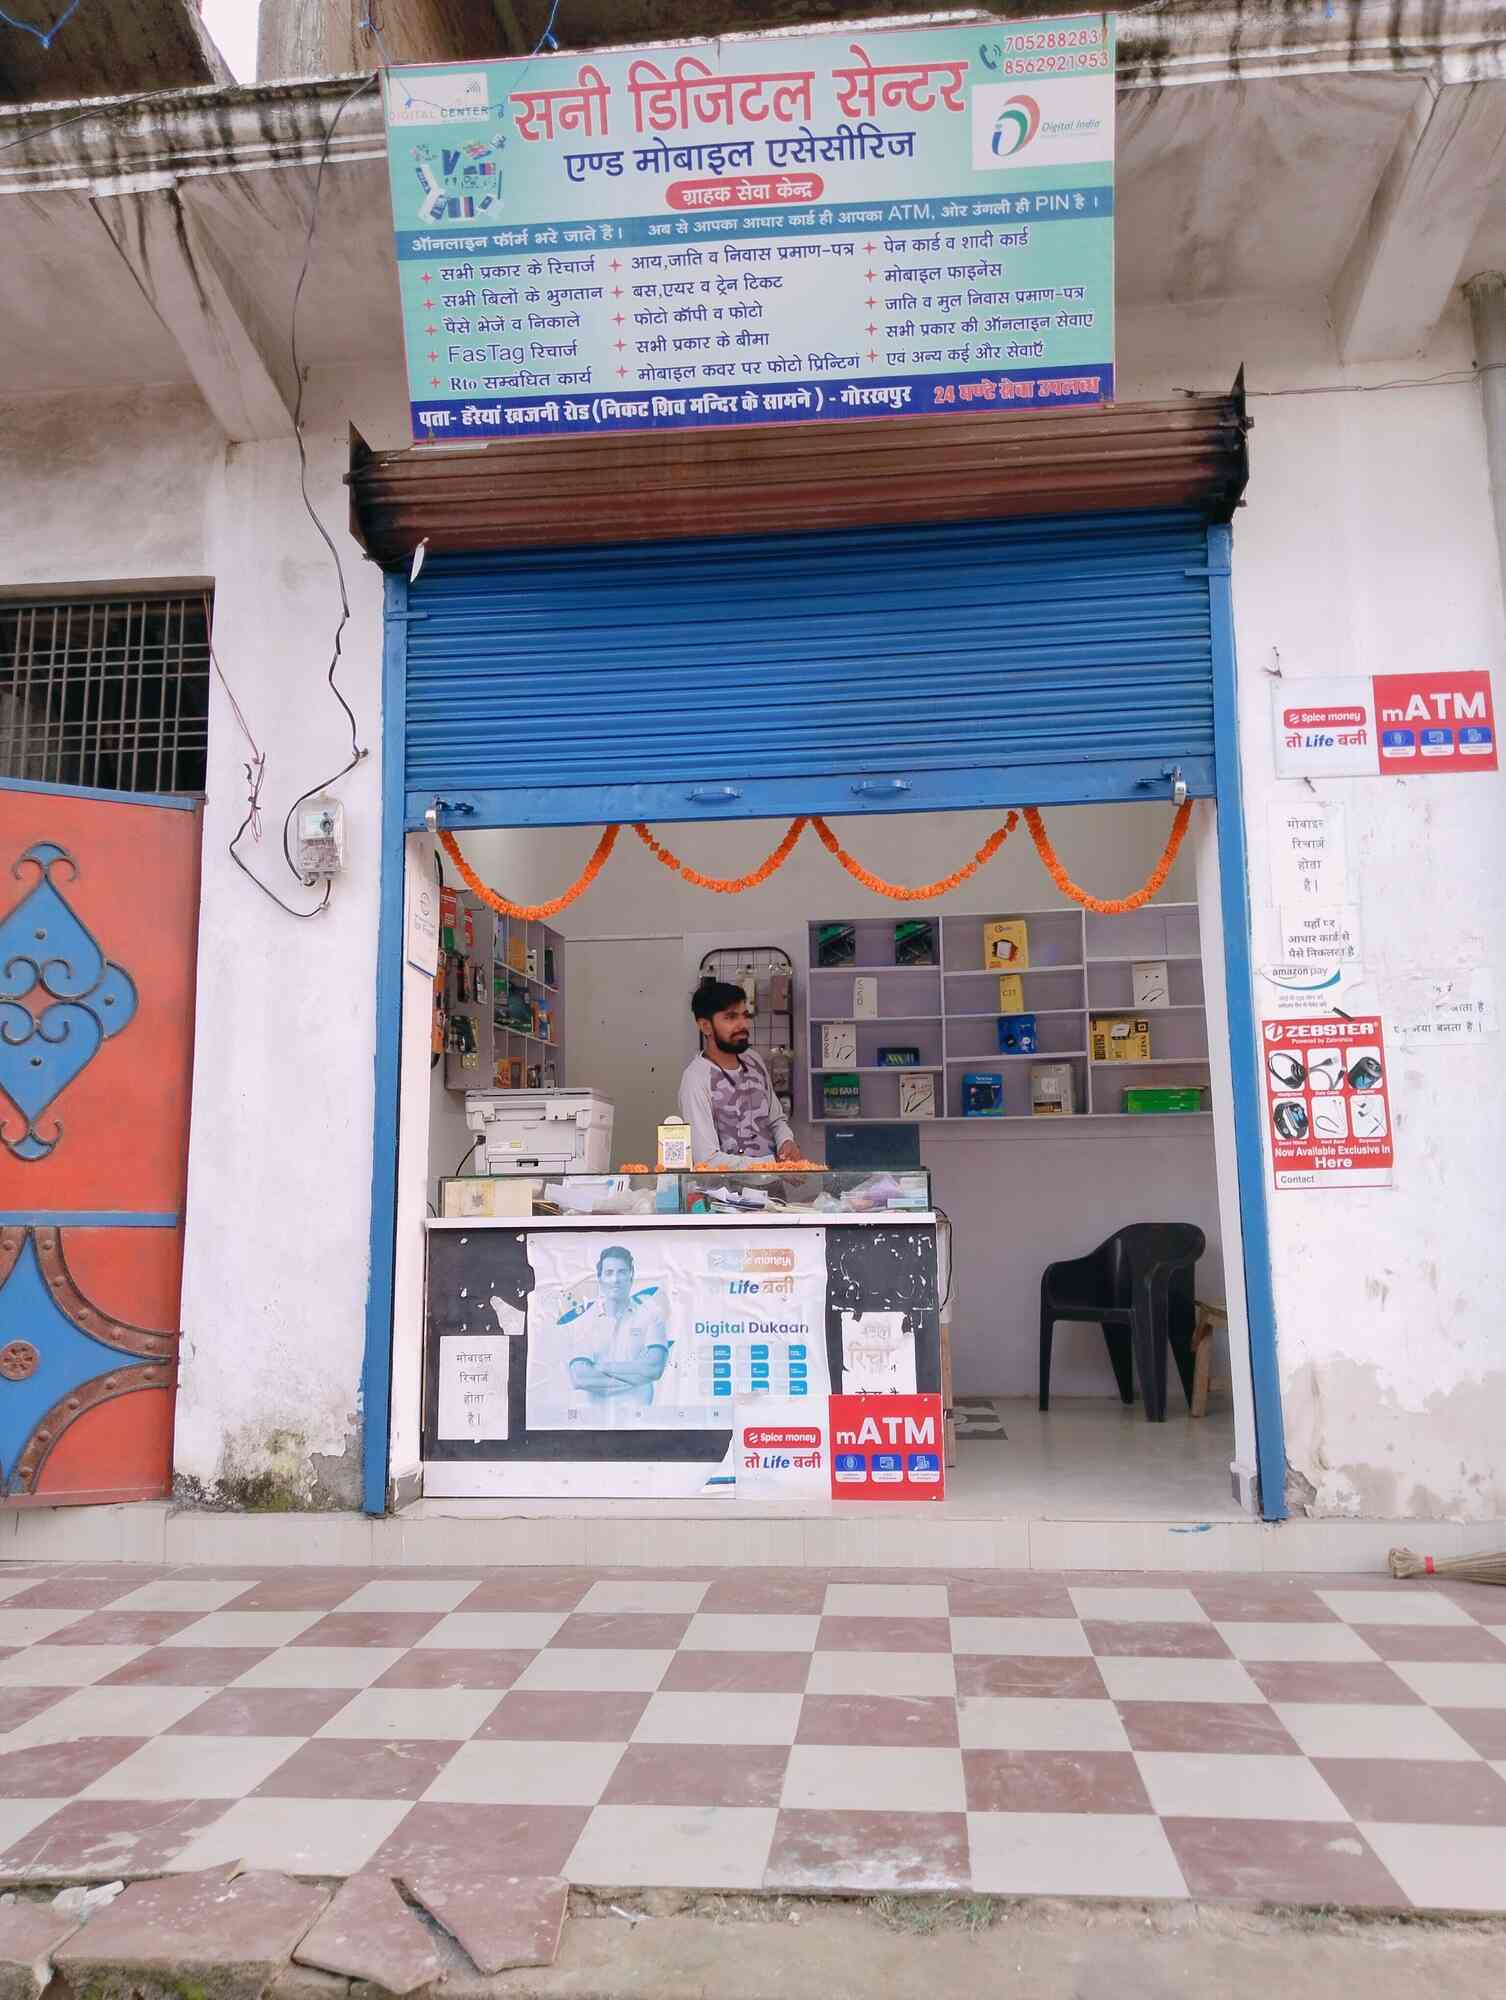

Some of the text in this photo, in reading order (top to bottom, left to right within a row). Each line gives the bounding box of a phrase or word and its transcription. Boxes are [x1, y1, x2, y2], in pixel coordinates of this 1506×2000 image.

[1005, 51, 1109, 74] 8562921953
[508, 43, 968, 142] सनी डिजिटल सेन्टर
[440, 106, 489, 119] CENTER
[1041, 118, 1102, 133] Digital India
[563, 122, 916, 182] एण्ड मोबाइल एसेसीरिज
[682, 176, 813, 206] ग्राहक सेवा केन्द्र
[648, 225, 671, 237] अब
[676, 221, 688, 235] से
[694, 219, 737, 234] आपका
[743, 214, 784, 230] आधार
[788, 208, 815, 227] कार्ड
[818, 209, 832, 225] ही
[838, 208, 883, 224] आपका
[1015, 197, 1030, 213] ही
[1035, 194, 1069, 212] PIN
[1074, 192, 1086, 210] है
[411, 236, 488, 253] ऑनलाइन
[535, 229, 558, 245] भरे
[563, 226, 596, 242] जाते
[883, 226, 1029, 254] पेन कार्ड व शादी कार्ड
[709, 251, 719, 264] व
[724, 244, 771, 264] निवास
[440, 254, 596, 282] सभी प्रकार के रिचार्ज
[884, 263, 942, 284] मोबाइल
[701, 280, 710, 293] व
[716, 274, 738, 295] ट्रेन
[743, 272, 783, 291] टिकट
[442, 283, 604, 309] सभी बिलों के भुगतान
[884, 292, 917, 311] जाति
[922, 296, 932, 308] व
[967, 288, 1009, 306] निवास
[444, 316, 470, 335] पैसे
[511, 318, 522, 331] व
[528, 311, 581, 330] निकाले
[633, 300, 763, 326] फोटो कॉपी व फोटो
[885, 319, 915, 338] सभी
[920, 321, 955, 337] प्रकार
[961, 316, 978, 334] की
[984, 316, 1050, 332] ऑनलाइन
[448, 339, 577, 364] FasTag रिचार्ज
[636, 329, 770, 353] सभी प्रकार के बीमा
[886, 347, 906, 366] एवं
[911, 349, 942, 364] अन्य
[947, 344, 970, 362] कई
[975, 342, 1002, 360] और
[450, 376, 477, 391] Rto
[557, 366, 593, 386] कार्य
[637, 362, 696, 383] मोबाइल
[703, 363, 735, 379] कवर
[741, 361, 761, 377] पर
[767, 354, 801, 374] फोटो
[934, 384, 955, 404] 24
[999, 376, 1035, 399] सेवा
[505, 401, 559, 424] खजनी
[563, 401, 590, 420] रोड
[652, 396, 686, 417] शिव
[689, 392, 738, 414] मन्दिर
[741, 391, 758, 411] के
[840, 385, 913, 408] गोरखपुर
[1301, 711, 1361, 724] Spice money
[1382, 692, 1486, 722] mATM
[1285, 729, 1367, 748] तो Life बनी
[1272, 967, 1328, 977] amazon pay
[1286, 1023, 1374, 1037] ZEBSTER
[1275, 1147, 1294, 1157] Now
[1296, 1147, 1336, 1156] Available
[1339, 1145, 1380, 1155] Exclusive
[1315, 1158, 1352, 1168] Here
[1280, 1175, 1314, 1184] Contact
[729, 1279, 759, 1294] Life
[763, 1276, 793, 1294] बनी
[695, 1321, 809, 1337] Digital Dukaan
[761, 1432, 816, 1443] Spice money
[837, 1416, 935, 1445] mATM
[744, 1452, 821, 1469] तो Life बनी
